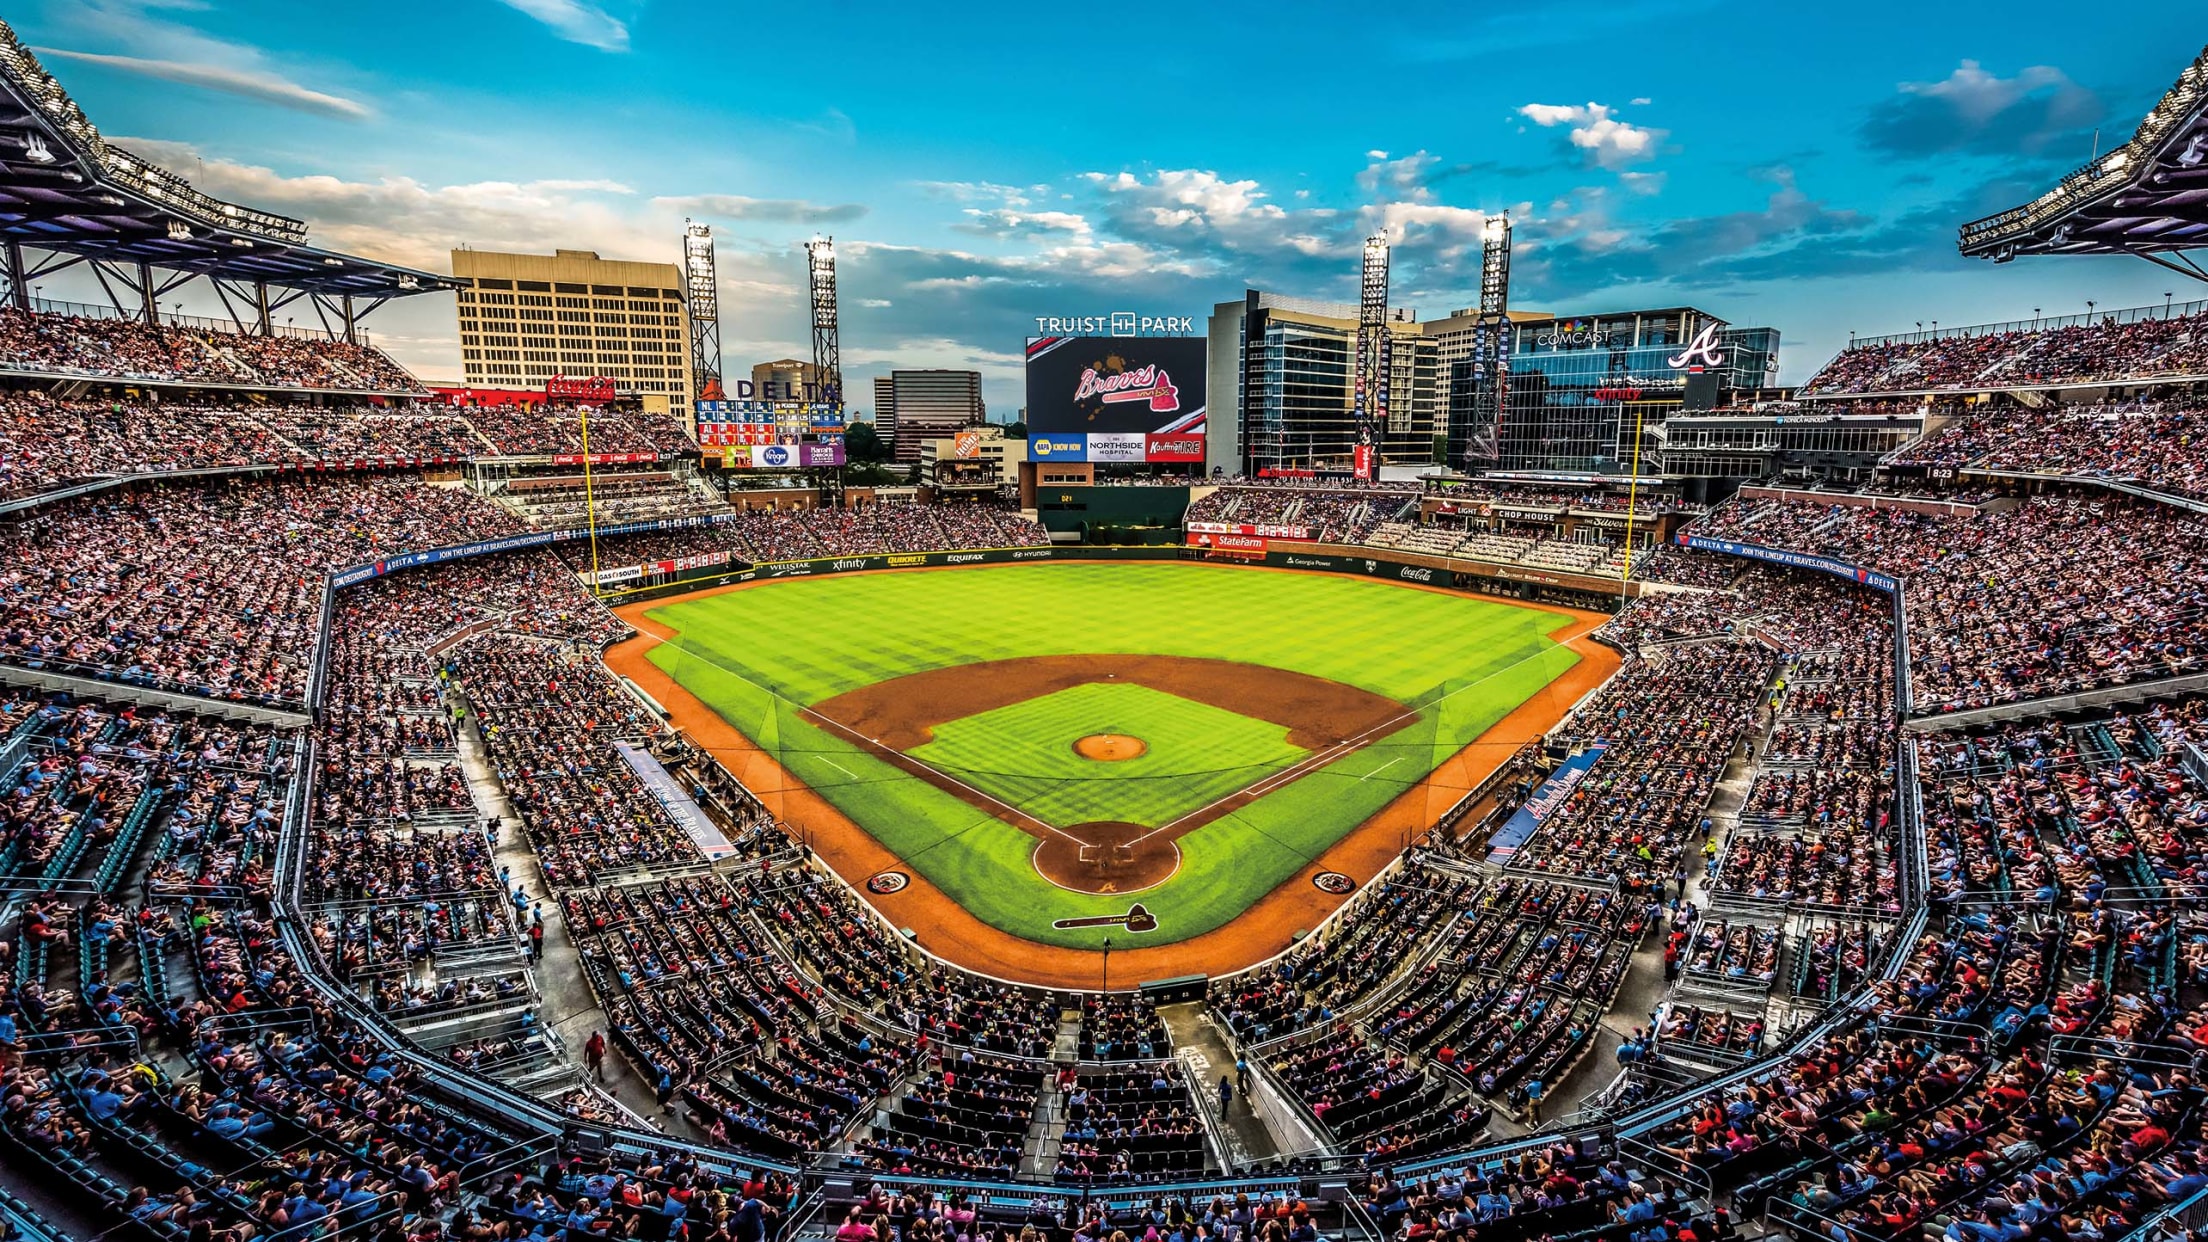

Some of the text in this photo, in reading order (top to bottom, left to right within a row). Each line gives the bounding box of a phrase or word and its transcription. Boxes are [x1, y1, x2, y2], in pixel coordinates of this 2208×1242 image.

[1035, 317, 1194, 333] TRUIST PARK
[1537, 331, 1610, 346] COMCAST
[1073, 364, 1155, 401] Braves
[737, 380, 838, 401] DELTA
[1594, 386, 1643, 401] xfinity
[701, 403, 712, 411] NL
[703, 425, 713, 434] AL
[1038, 443, 1050, 451] NAPA
[1175, 441, 1201, 454] TIRE
[765, 450, 787, 464] Kroger
[1932, 469, 1952, 479] 8:23
[1458, 507, 1478, 515] LIGHT
[1499, 510, 1555, 522] CHOP HOUSE
[1593, 517, 1624, 528] Silver
[391, 556, 413, 568] DELTA
[439, 550, 452, 560] JOIN
[452, 549, 463, 558] THE
[464, 545, 482, 556] LINEUP
[482, 544, 490, 553] AT
[887, 555, 927, 564] QUIKRETE
[947, 554, 985, 563] EQUIFAX
[769, 562, 811, 571] WELLSTAR
[832, 558, 867, 571] xfinity
[1294, 559, 1314, 567] Georgia
[1698, 540, 1721, 549] DELTA
[1742, 547, 1754, 556] JOIN
[1754, 548, 1765, 557] THE
[1765, 551, 1784, 562] LINEUP
[1873, 577, 1895, 590] DELTA
[598, 569, 640, 581] GAS SOUTH
[681, 814, 708, 841] BRAVES
